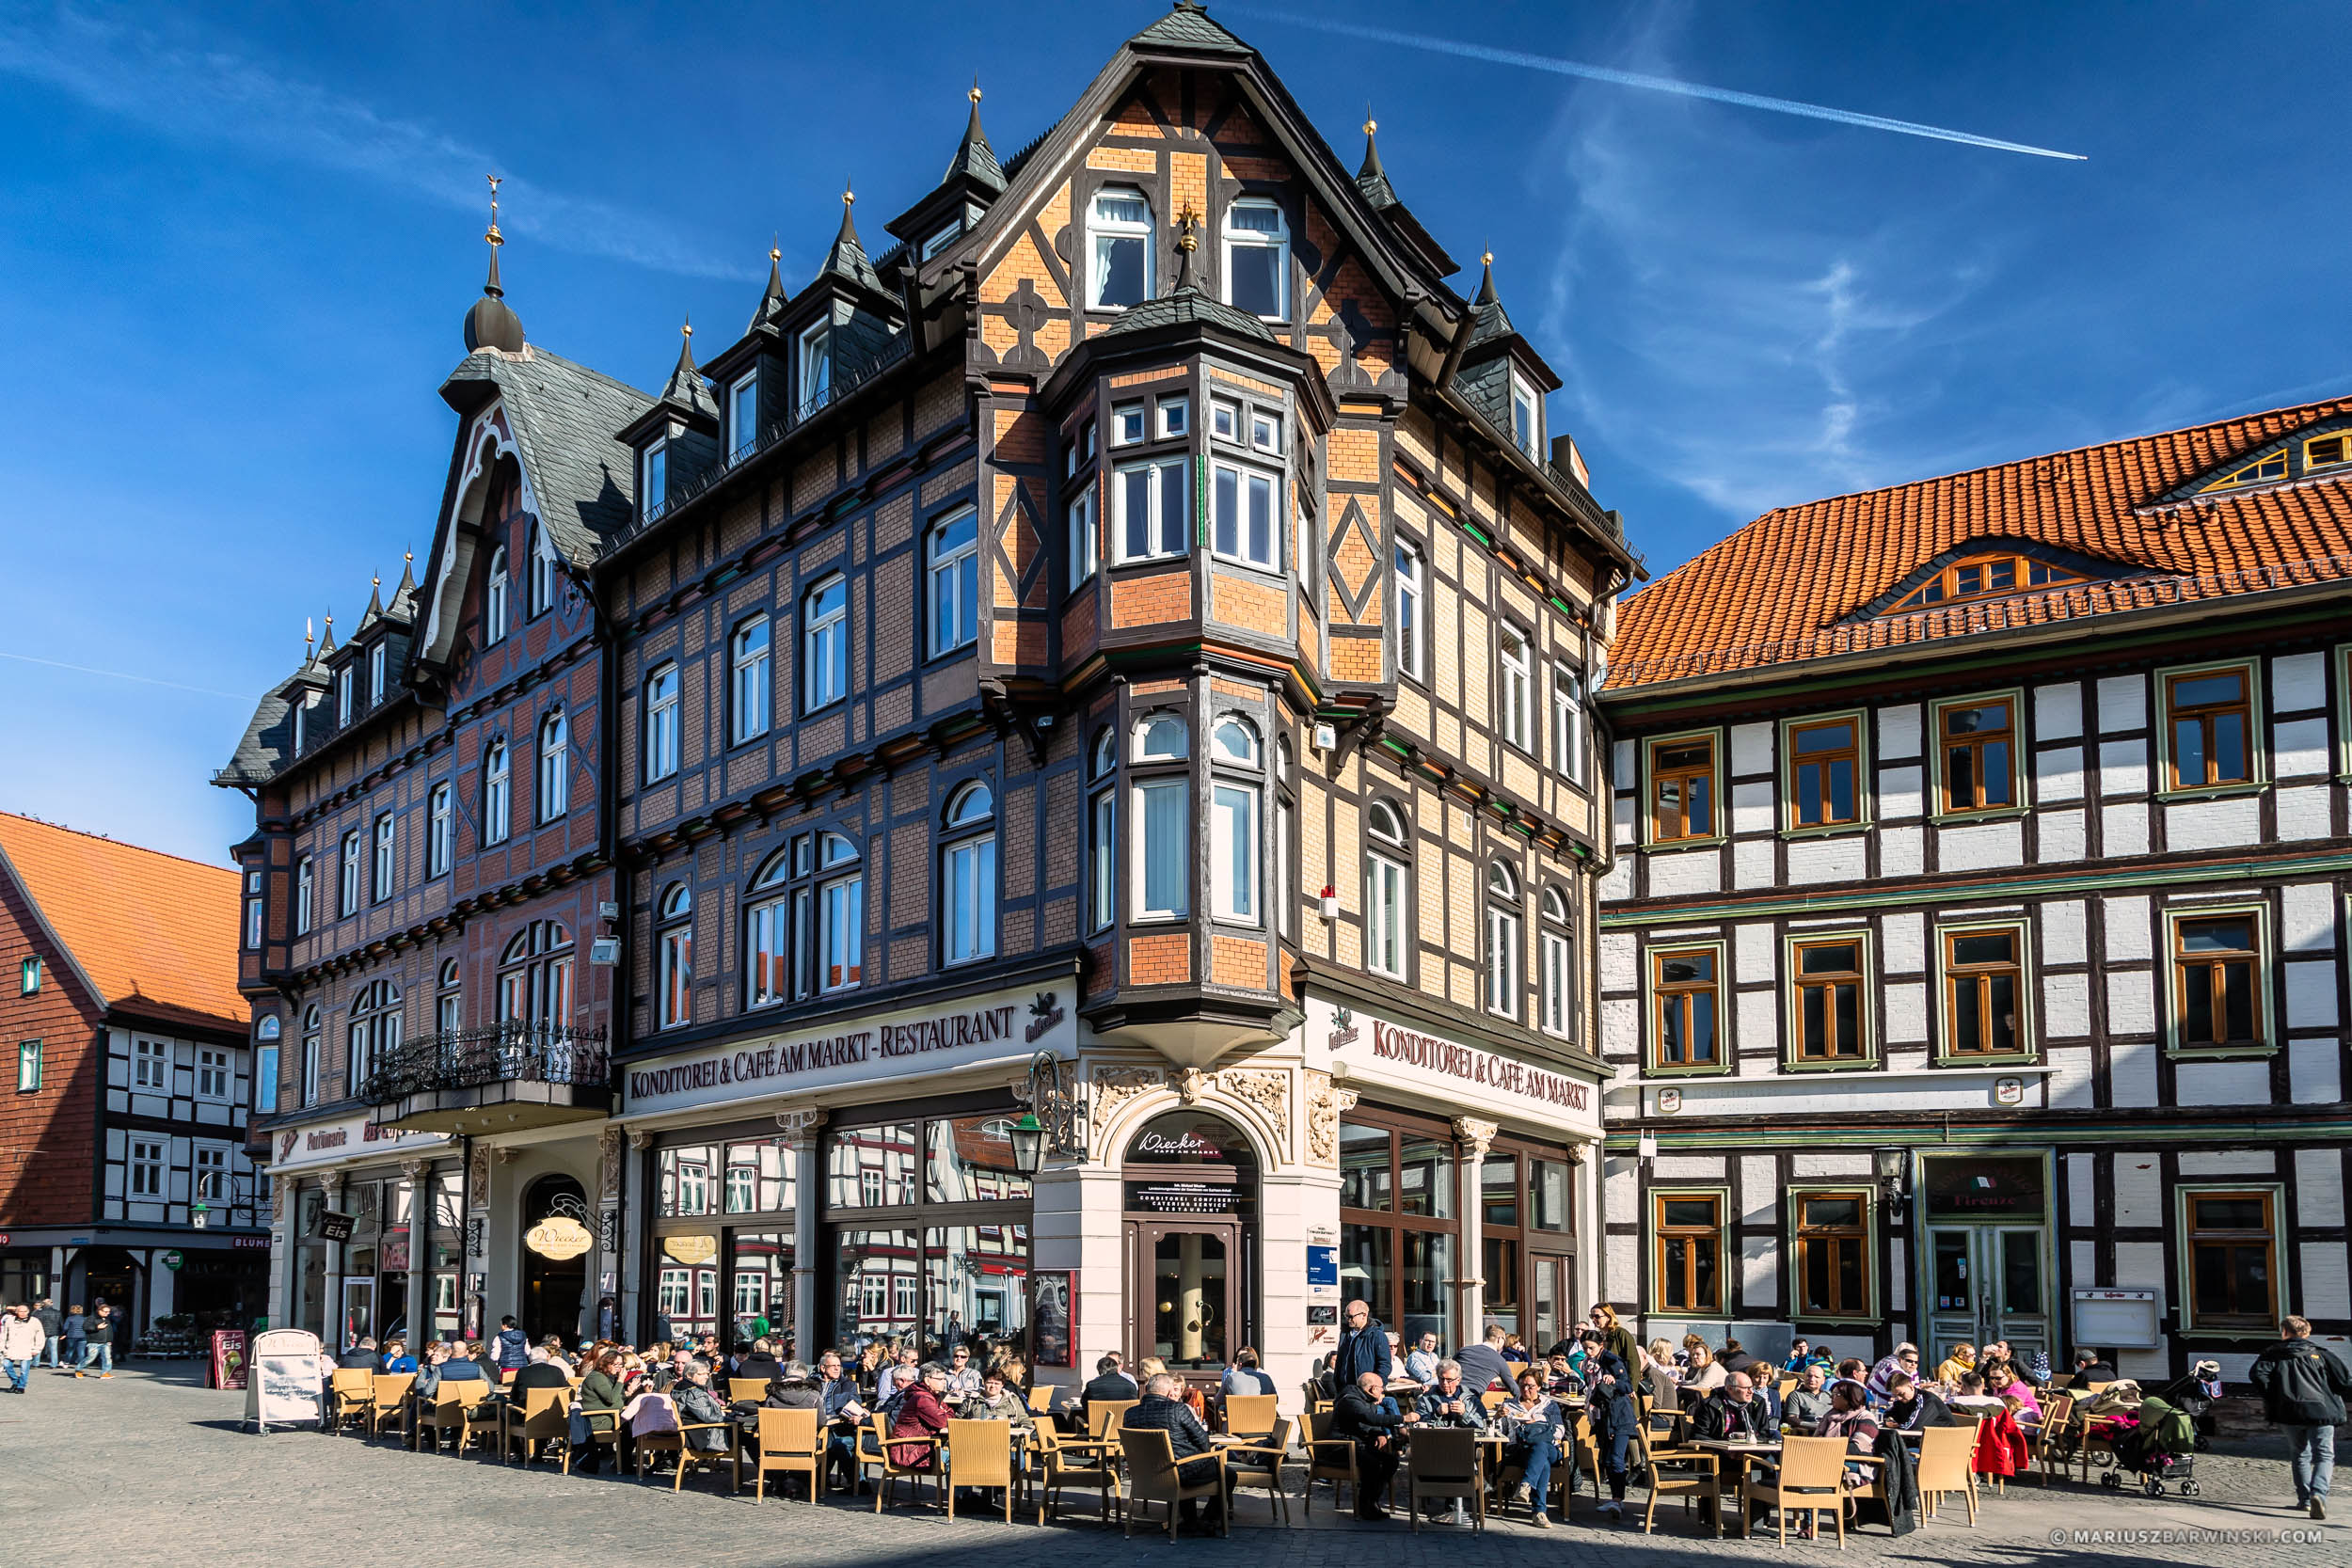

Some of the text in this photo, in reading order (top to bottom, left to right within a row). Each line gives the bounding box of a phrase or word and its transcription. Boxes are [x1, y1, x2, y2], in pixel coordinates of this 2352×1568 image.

[630, 1059, 718, 1100] KONDITOREI
[719, 1057, 732, 1085] &
[734, 1041, 775, 1082] CAFÉ
[777, 1043, 804, 1075] AM
[1372, 1020, 1589, 1111] KONDITOREI & CAFÉ AM MARKT
[325, 1225, 347, 1238] Eis
[234, 1238, 271, 1248] BLUME
[222, 1340, 242, 1350] Eis
